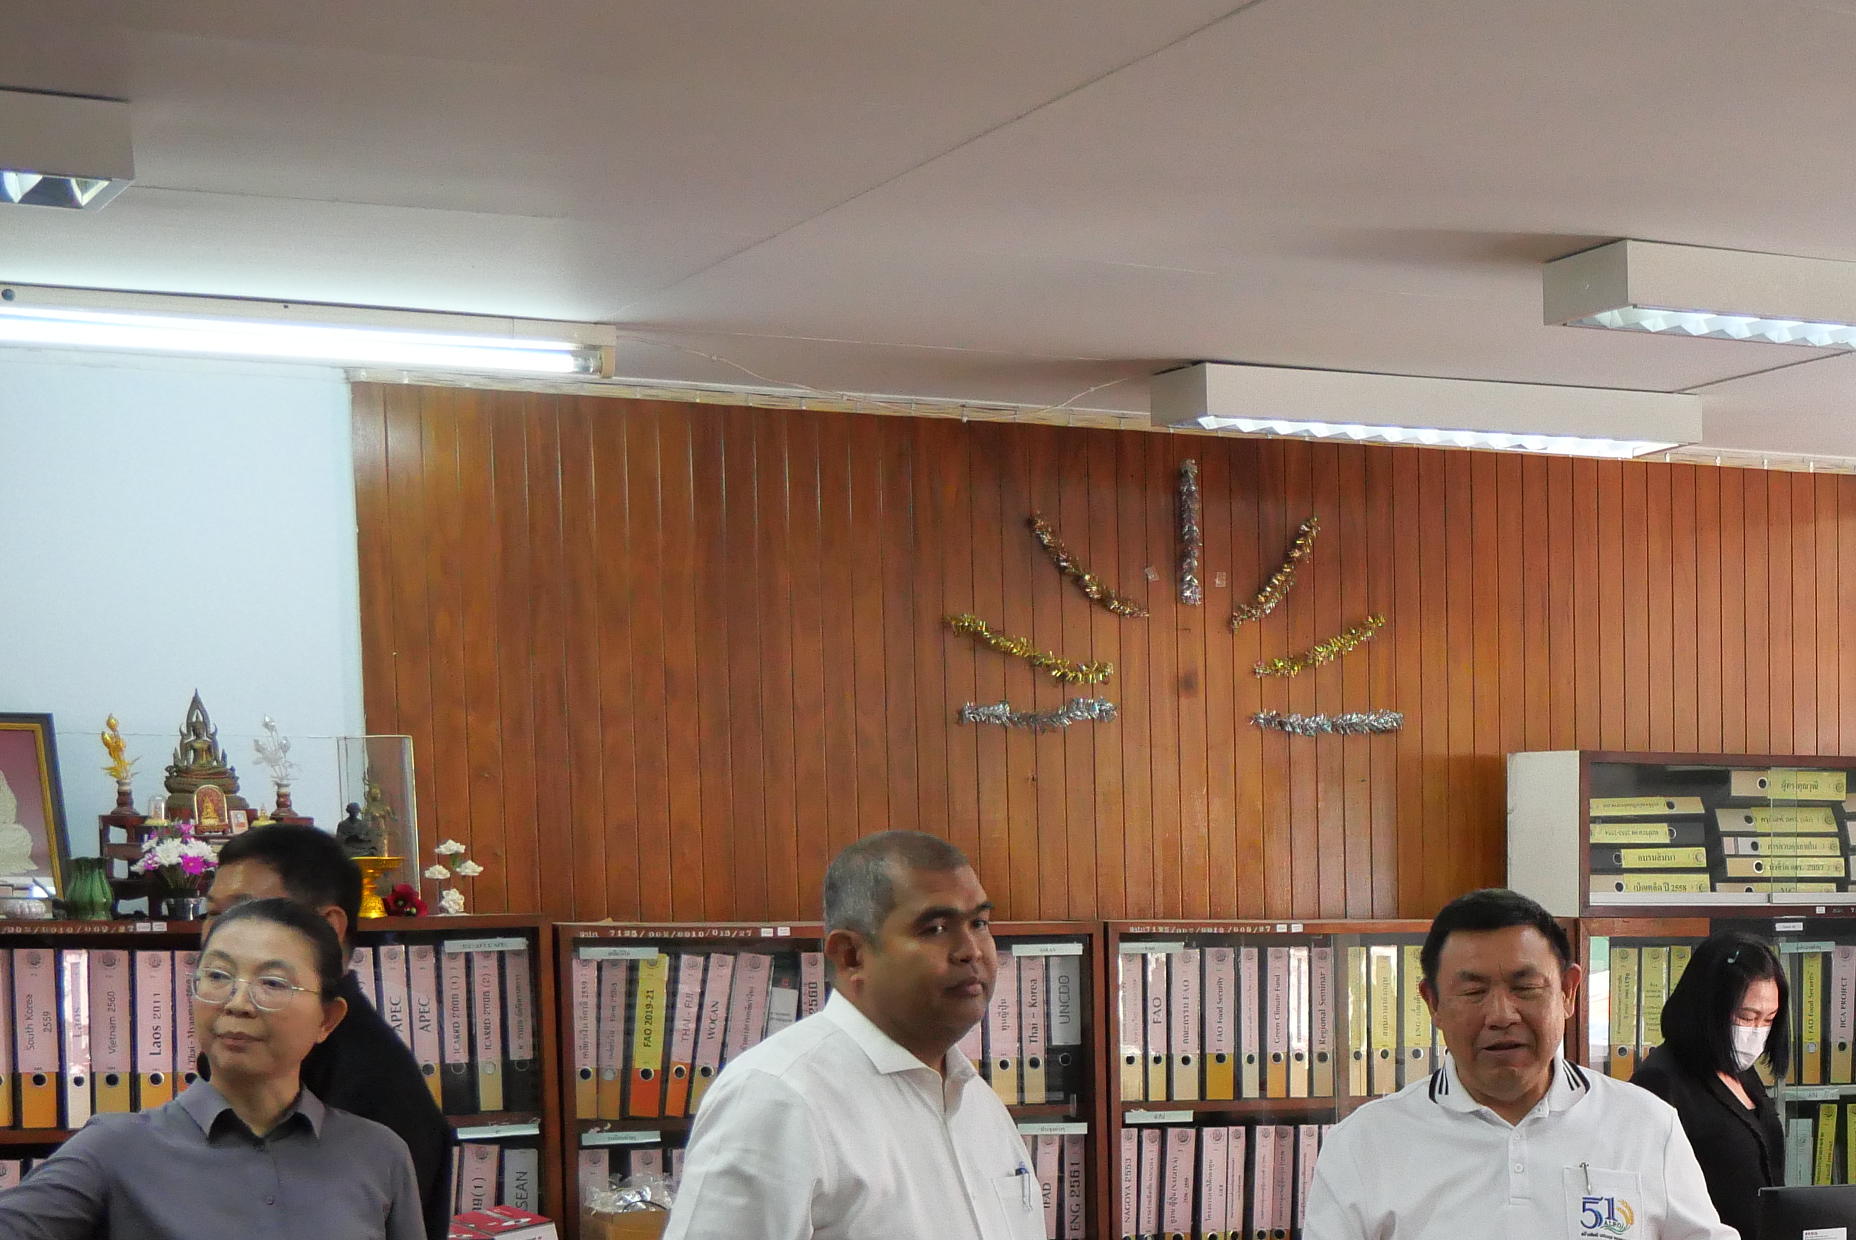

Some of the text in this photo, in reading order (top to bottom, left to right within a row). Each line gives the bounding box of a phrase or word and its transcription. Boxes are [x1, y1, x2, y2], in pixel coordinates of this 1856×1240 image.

[1027, 978, 1038, 1008] Korea
[1152, 996, 1162, 1025] FAO
[1216, 977, 1225, 1042] FAO Food Security
[1273, 995, 1281, 1021] Climate
[1318, 971, 1329, 1046] Regional Seminar
[1840, 977, 1848, 1012] PROJECT
[23, 992, 35, 1051] South Korea
[42, 1010, 53, 1034] 2559
[107, 989, 118, 1055] Vietnam 2560
[149, 992, 163, 1057] Laos 2011
[389, 996, 403, 1032] APEC
[417, 996, 431, 1034] APEC
[643, 989, 656, 1048] FAO 2019-21
[706, 999, 720, 1041] WOCAN
[483, 1019, 493, 1051] ICARRD
[1027, 1022, 1039, 1045] Thai
[1273, 1023, 1281, 1044] Green
[514, 1170, 528, 1212] SEAN
[1042, 1182, 1052, 1209] IFAD
[1069, 1161, 1080, 1232] ENG 2561
[1124, 1158, 1132, 1224] NAGOYA 2553
[1580, 1196, 1618, 1230] 51
